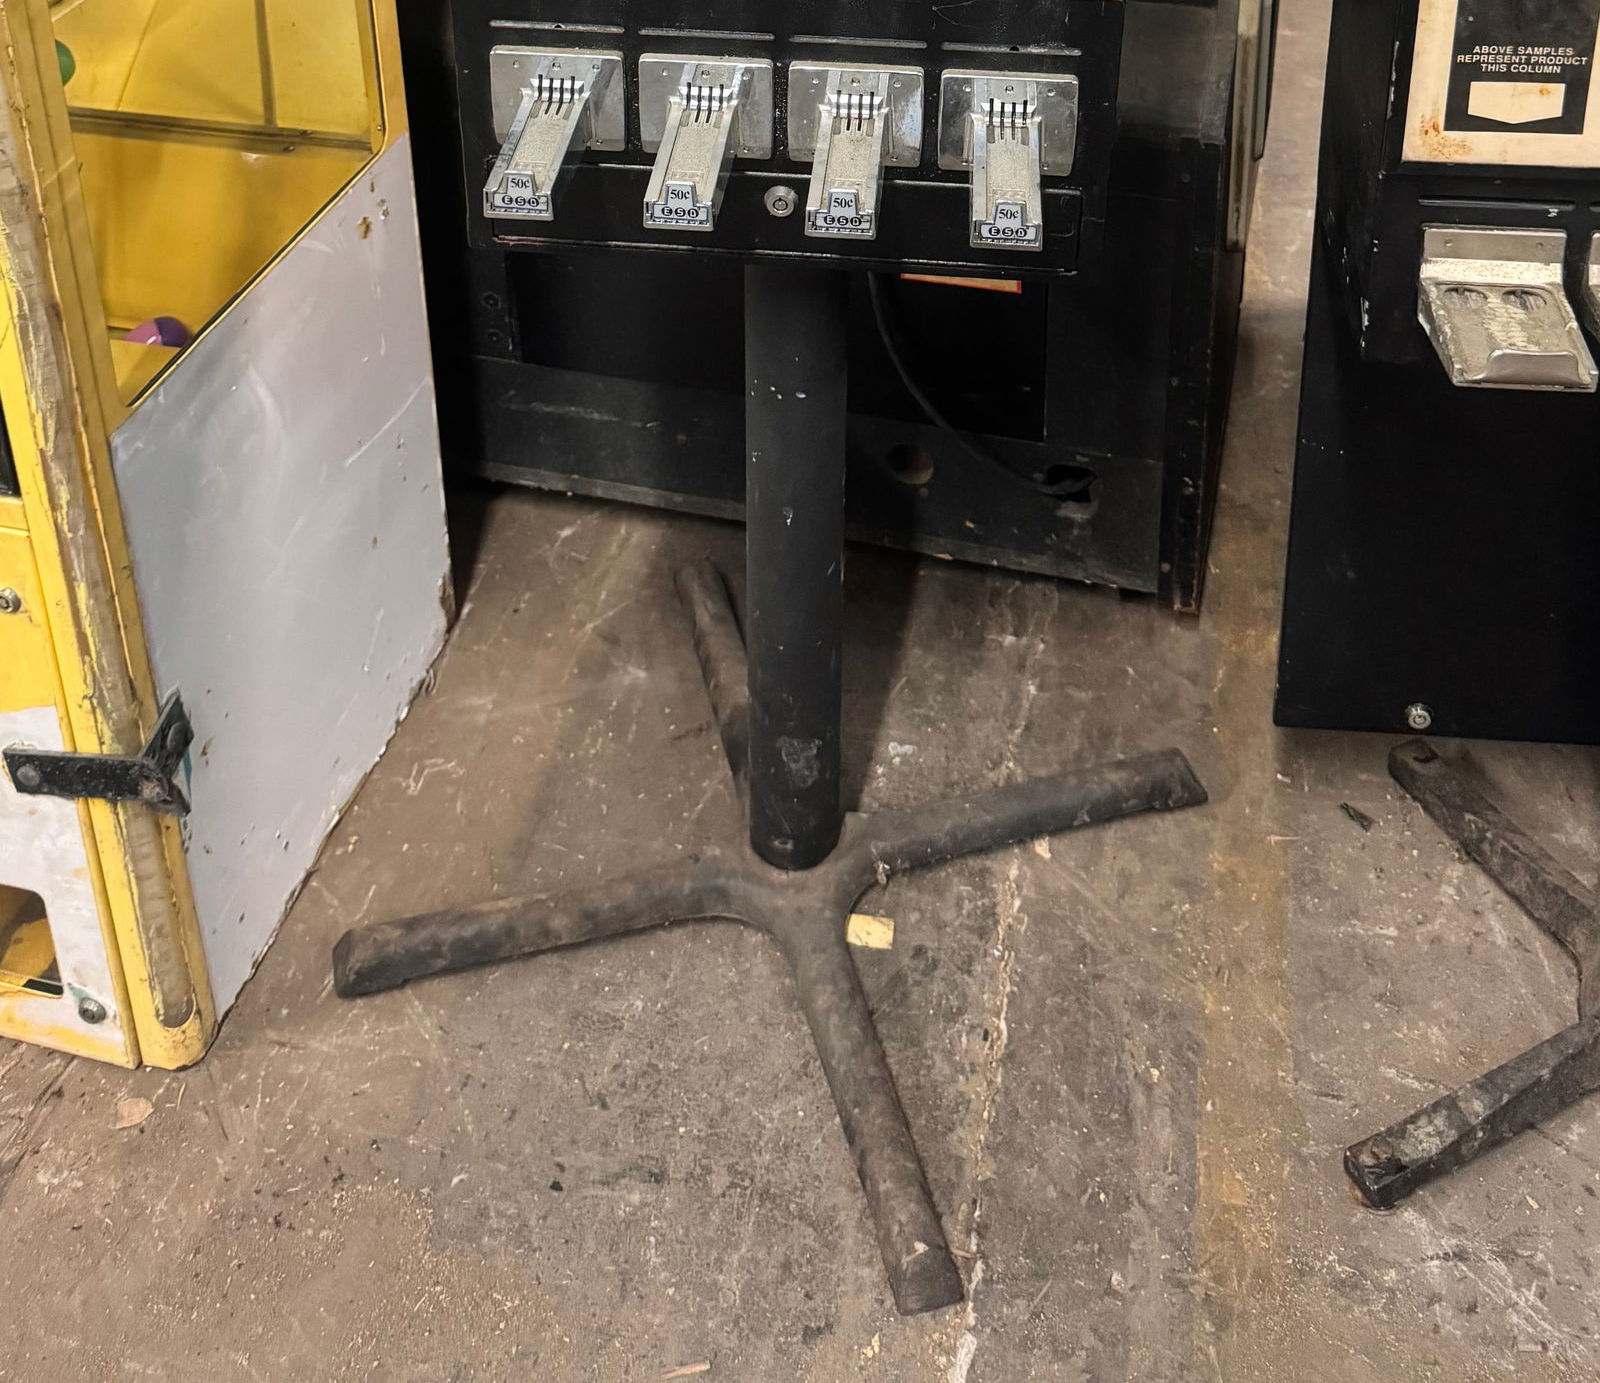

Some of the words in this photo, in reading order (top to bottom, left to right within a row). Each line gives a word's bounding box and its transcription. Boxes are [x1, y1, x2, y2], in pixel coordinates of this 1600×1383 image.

[1473, 45, 1514, 54] ABOVE
[1517, 46, 1574, 56] SAMPLES
[1457, 55, 1527, 64] REPRESENT
[1530, 55, 1588, 65] PRODUCT
[1481, 63, 1507, 72] THIS
[1511, 64, 1561, 73] COLUMN
[510, 177, 530, 189] 50¢
[670, 189, 691, 201] 50¢
[833, 197, 853, 209] 50¢
[999, 209, 1019, 220] 50¢
